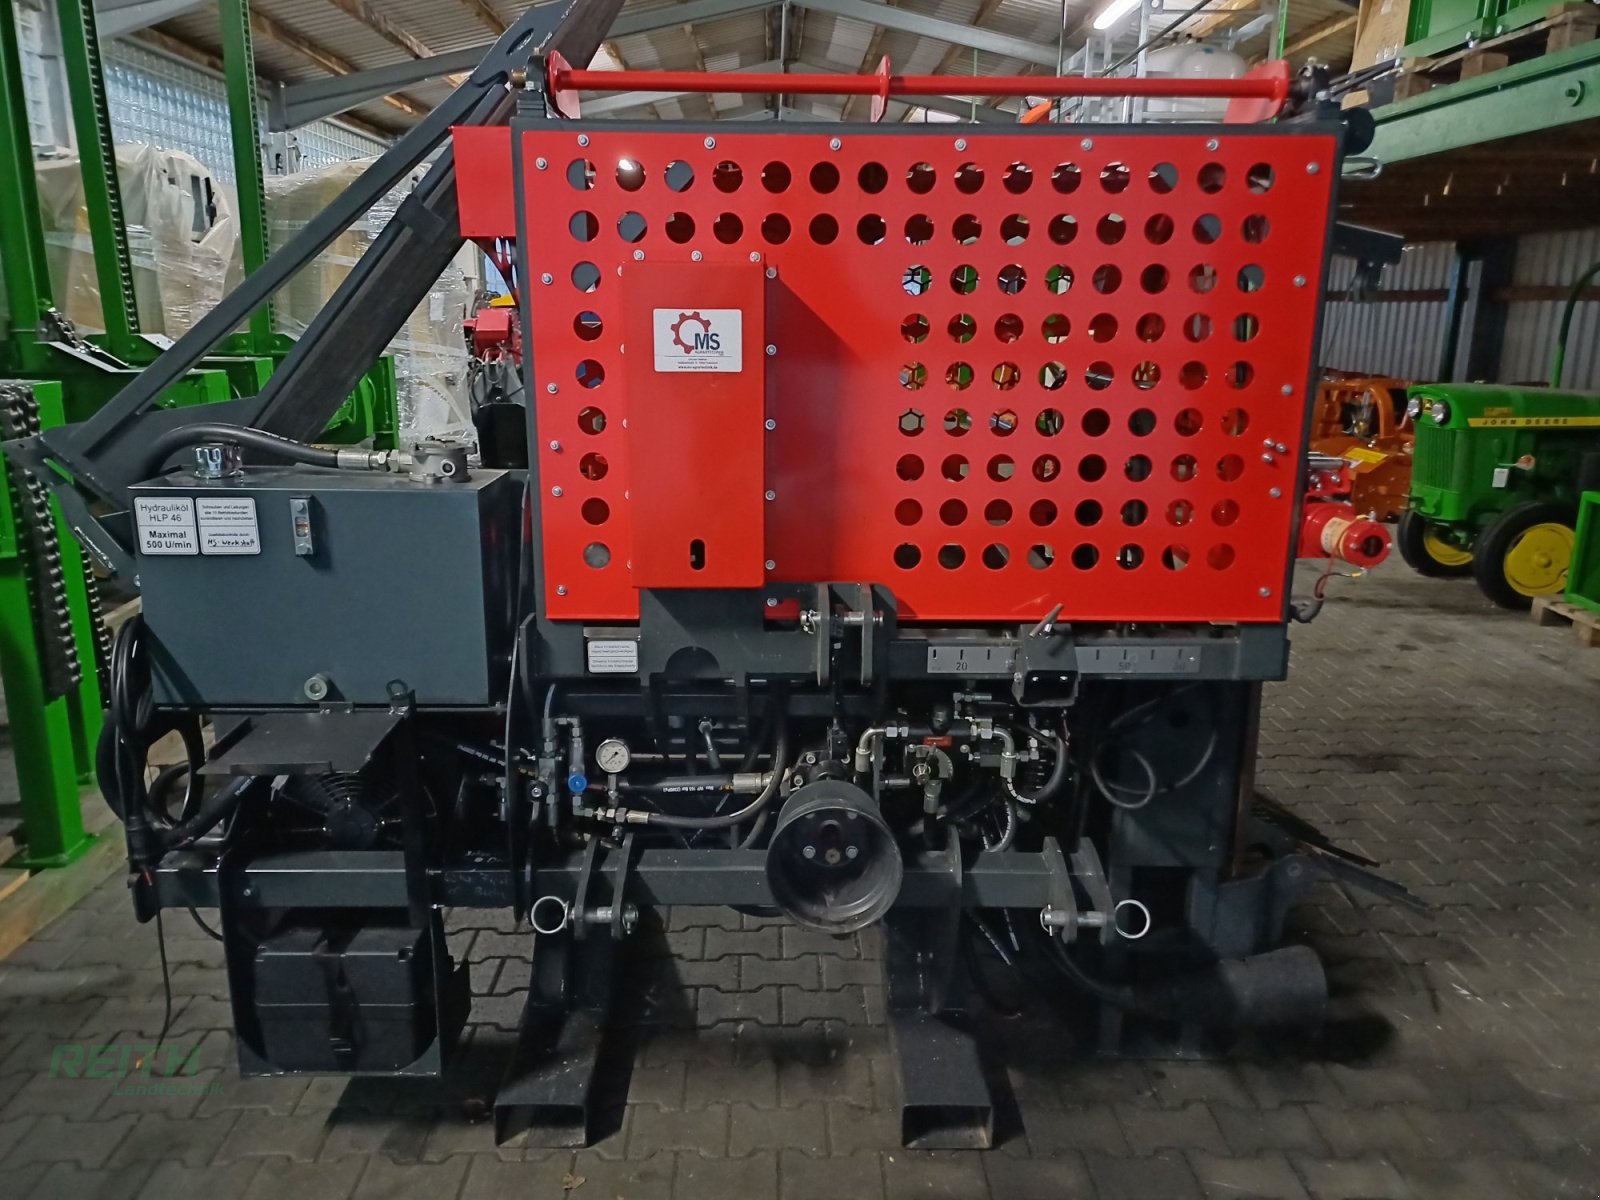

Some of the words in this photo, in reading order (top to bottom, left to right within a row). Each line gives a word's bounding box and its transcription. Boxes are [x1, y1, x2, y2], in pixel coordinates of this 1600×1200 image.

[694, 333, 720, 350] MS
[140, 504, 188, 513] Hydrauliköl
[146, 540, 163, 548] 500
[165, 540, 192, 548] U/min
[956, 662, 968, 671] 20
